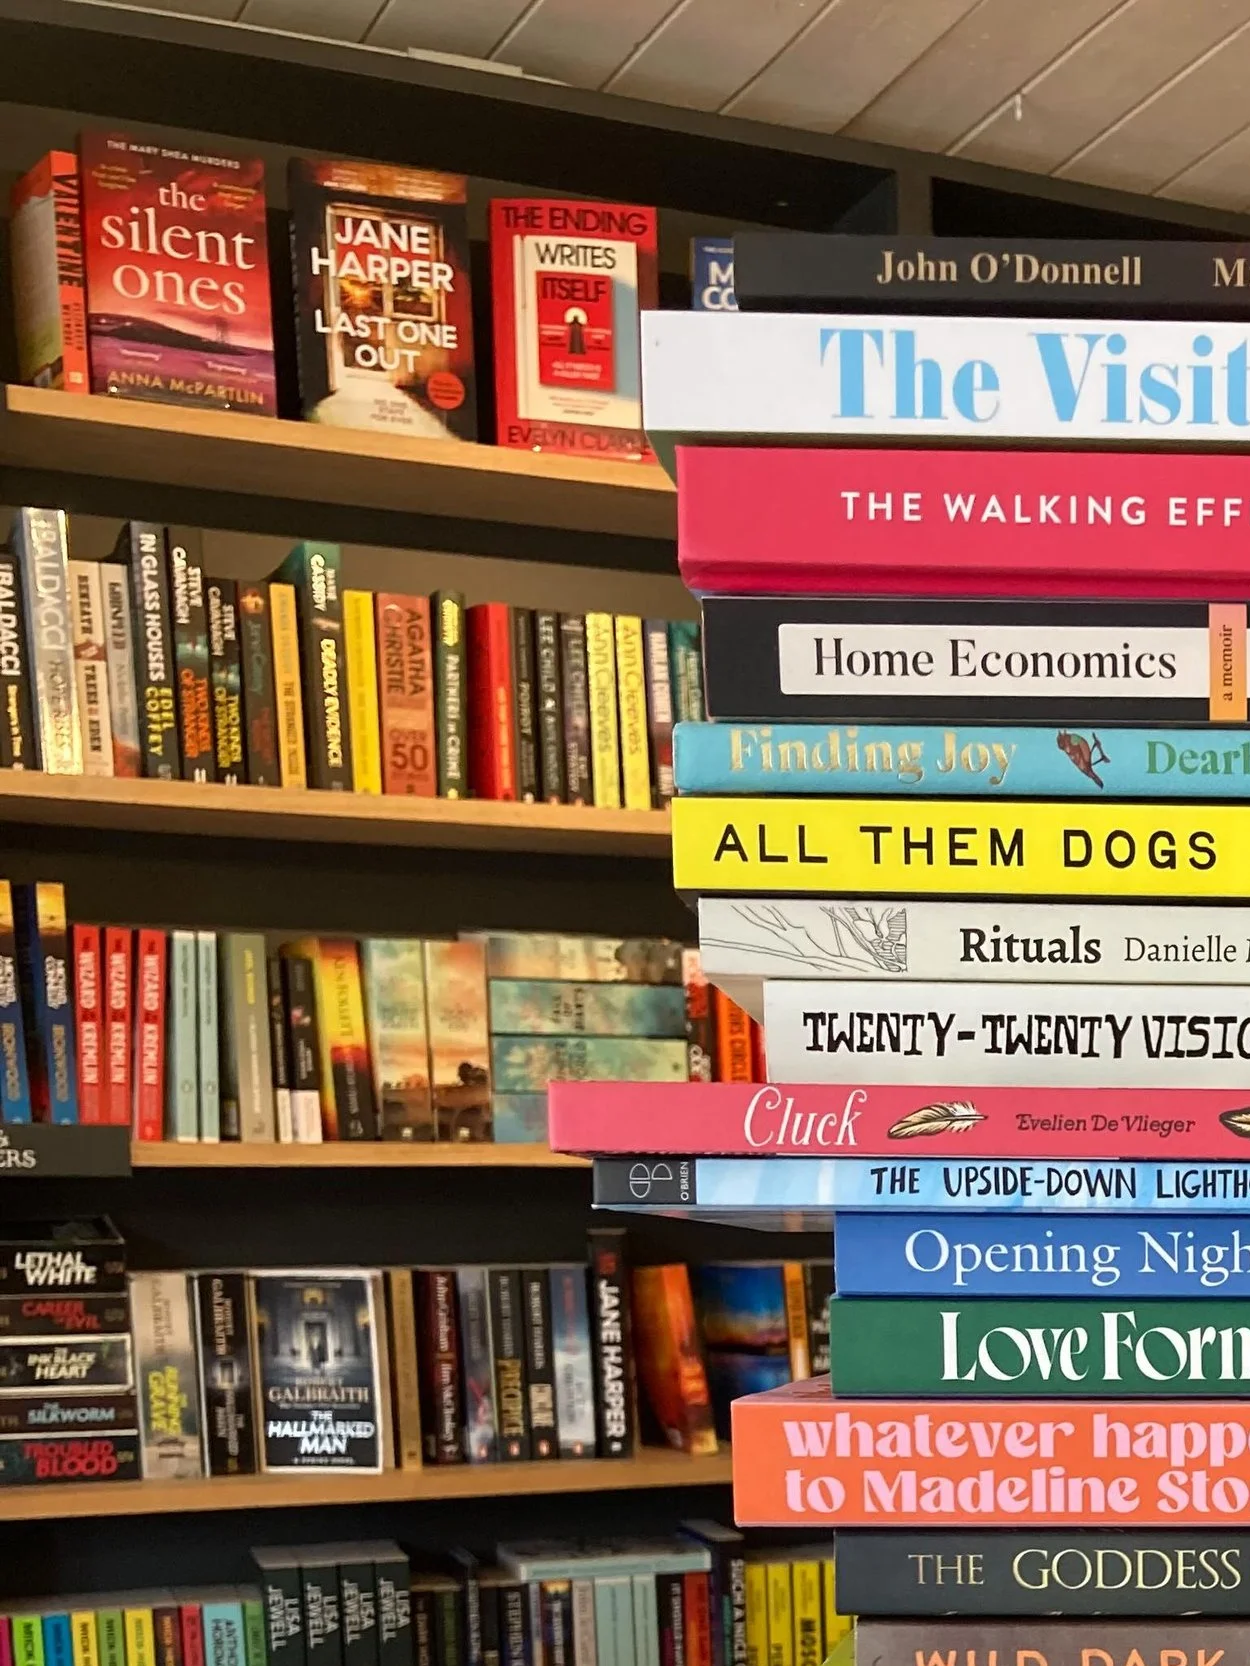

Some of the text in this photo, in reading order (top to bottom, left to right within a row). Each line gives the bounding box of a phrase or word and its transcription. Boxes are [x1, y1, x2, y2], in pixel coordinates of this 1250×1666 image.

[158, 182, 206, 211] the
[100, 207, 256, 270] silent
[334, 217, 430, 255] JANE
[502, 205, 647, 236] THE ENDING
[311, 247, 455, 293] HARPER
[535, 242, 616, 269] WRITES
[877, 251, 1141, 286] John O'Donnell
[112, 264, 246, 315] ones
[541, 277, 606, 302] ITSELF
[314, 308, 458, 350] LAST ONE
[354, 344, 421, 374] OUT
[819, 328, 1000, 421] The
[107, 370, 163, 387] ANNA
[384, 604, 404, 696] CHRISTIE
[403, 607, 426, 698] AGATHA
[814, 637, 1177, 679] Home Economics
[1222, 624, 1233, 701] a memoir
[743, 1086, 868, 1148] Cluck
[1016, 1113, 1196, 1138] Evelien De Vlieger
[14, 1251, 84, 1270] LETHAL
[25, 1266, 97, 1286] WHITE
[905, 1230, 1120, 1287] Opening
[600, 1280, 626, 1438] JANE HARPER
[23, 1440, 114, 1457] TROUBLED
[268, 1421, 374, 1439] HALLMARKED
[300, 1439, 346, 1455] MAN
[783, 1412, 1075, 1458] whatever
[35, 1456, 117, 1478] BLOOD
[784, 1470, 845, 1513] to
[863, 1467, 1140, 1514] Madeline
[268, 1585, 286, 1651] JEWELL
[285, 1598, 300, 1636] LISA
